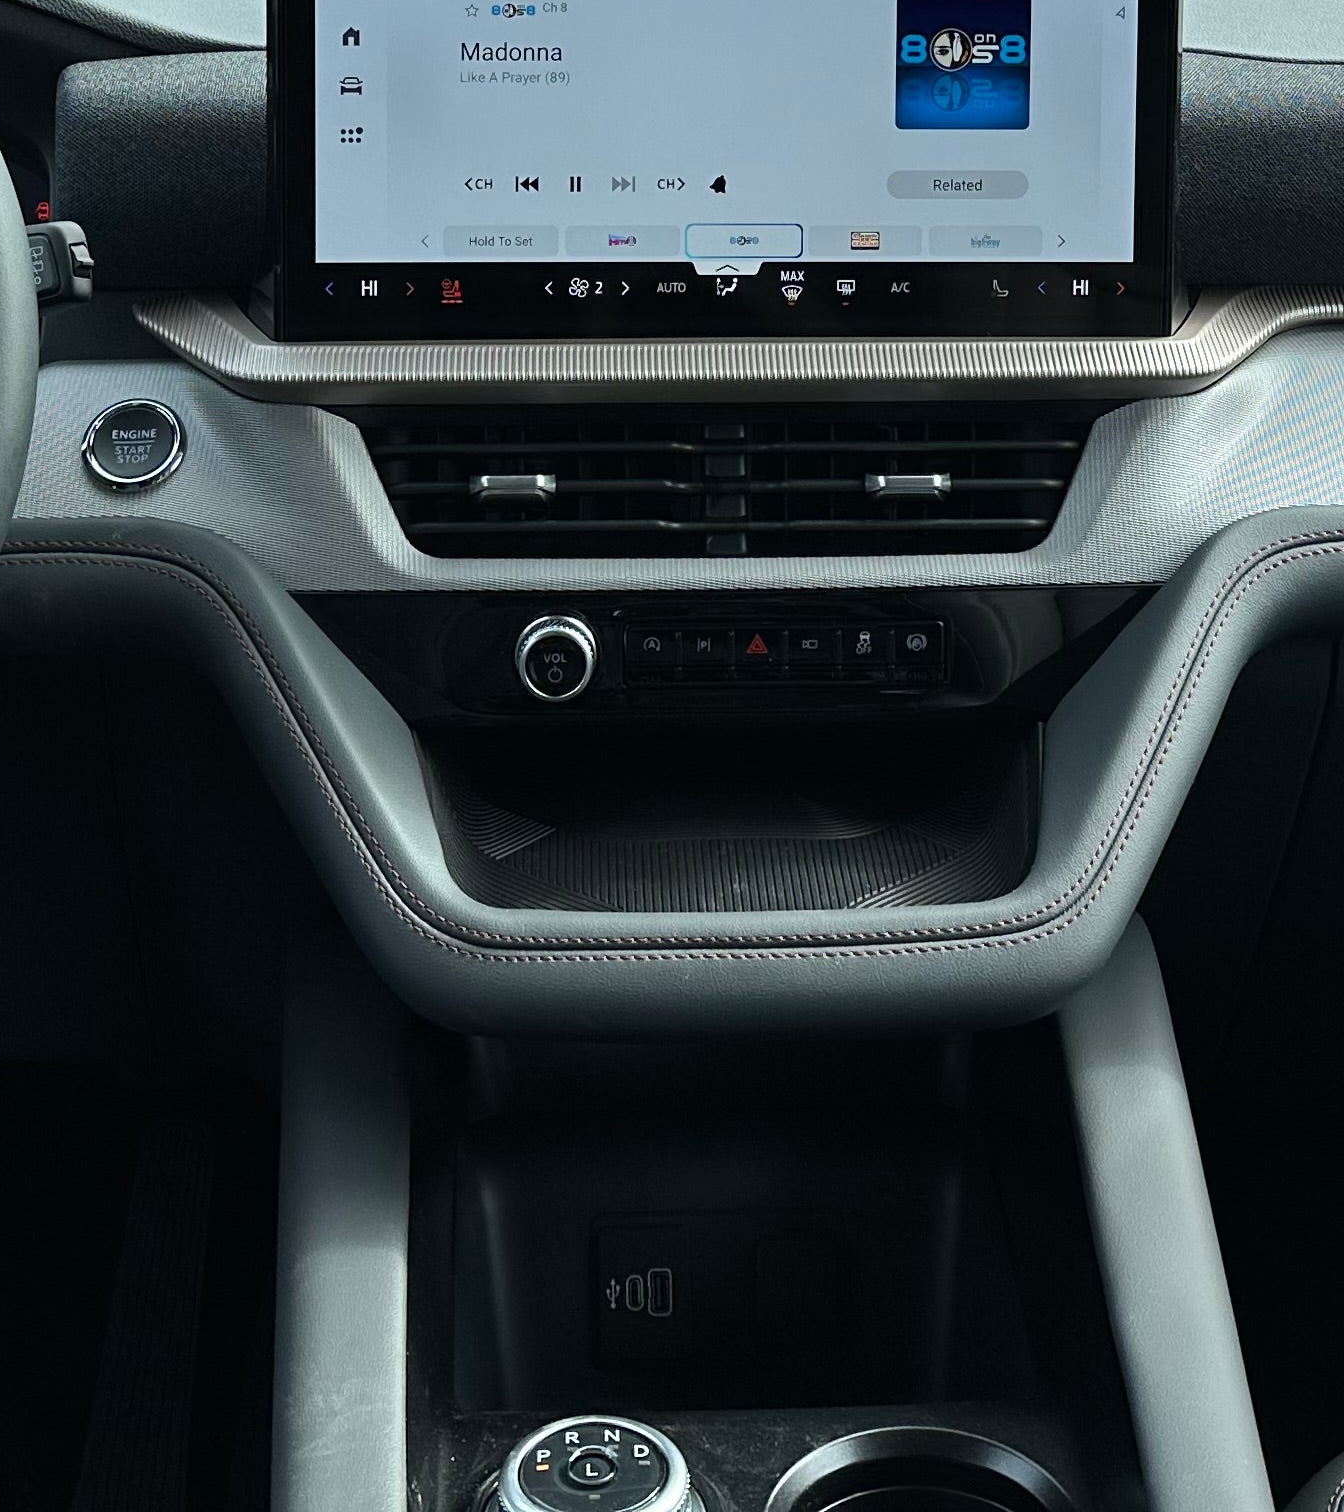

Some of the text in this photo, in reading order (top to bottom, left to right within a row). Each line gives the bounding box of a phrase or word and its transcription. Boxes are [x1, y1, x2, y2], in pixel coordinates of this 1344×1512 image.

[542, 2, 568, 14] Ch 8
[460, 42, 563, 62] Madonna
[459, 71, 571, 86] Like A Prayer (89)
[932, 179, 984, 192] Related
[469, 235, 533, 247] Hold To Set
[780, 271, 805, 282] MAX
[361, 280, 378, 297] HI
[595, 282, 603, 295] 2
[657, 282, 686, 294] AUTO
[891, 282, 910, 294] A/C
[1072, 280, 1089, 296] HI
[112, 429, 157, 439] ENGINE
[114, 444, 152, 455] START
[117, 454, 149, 464] STOP
[544, 653, 567, 664] VOL
[565, 1431, 581, 1445] R
[604, 1428, 621, 1442] N
[536, 1449, 552, 1464] P
[634, 1445, 650, 1458] D
[586, 1464, 599, 1477] L
